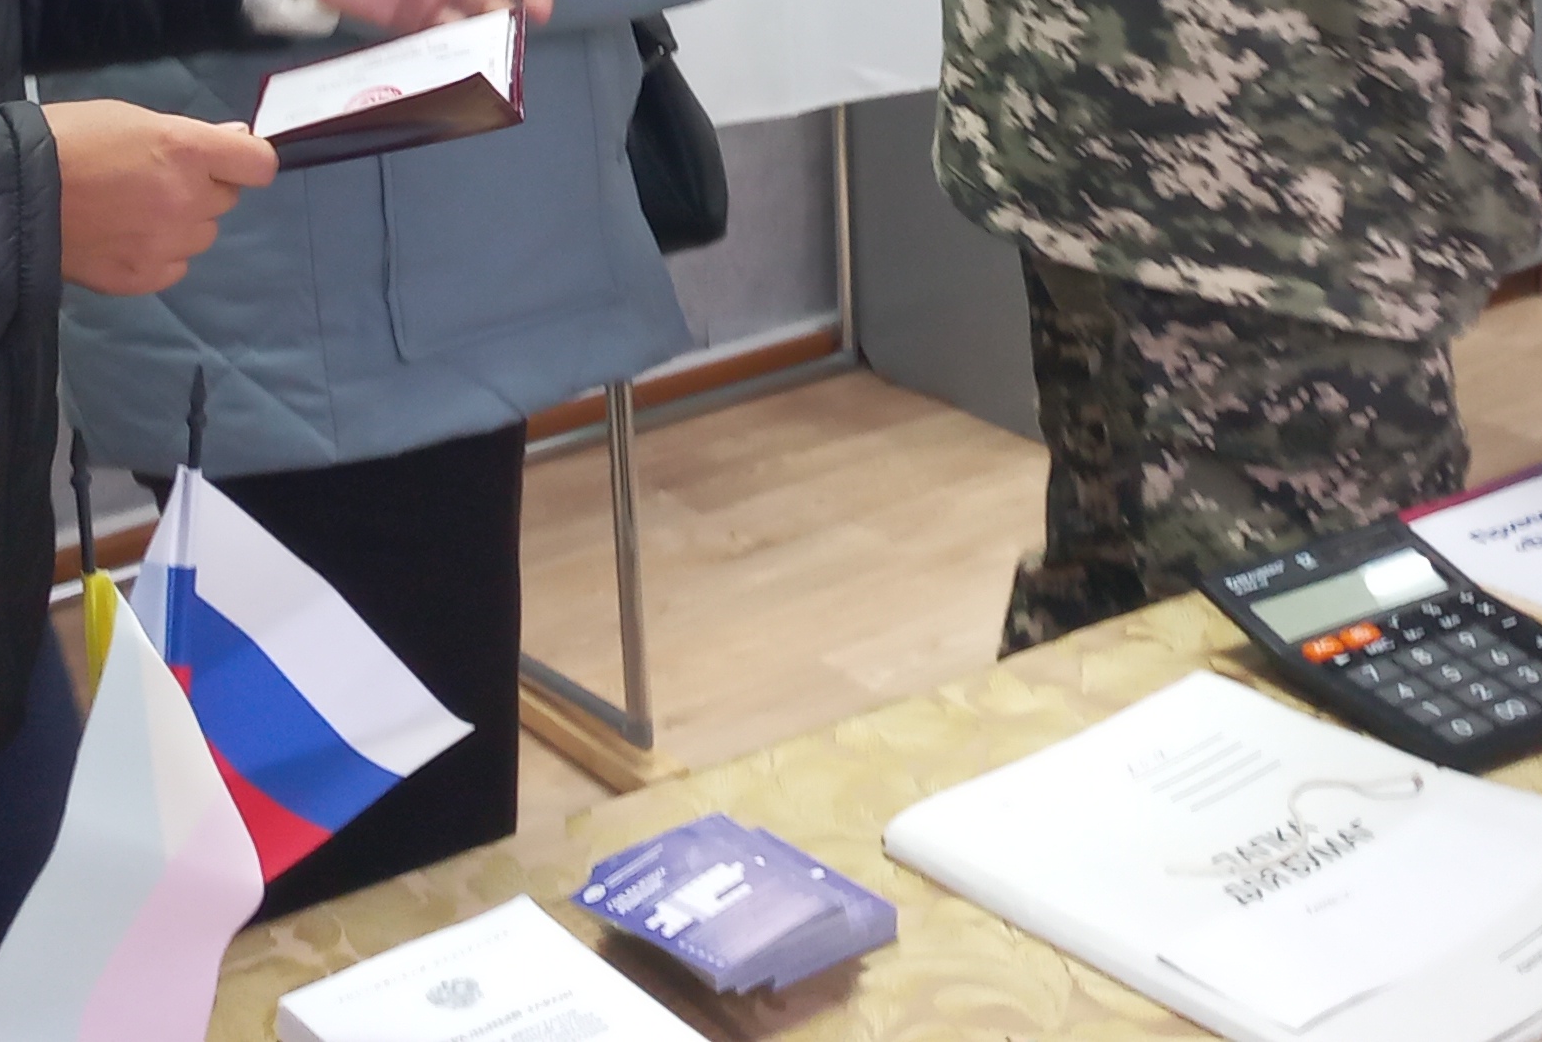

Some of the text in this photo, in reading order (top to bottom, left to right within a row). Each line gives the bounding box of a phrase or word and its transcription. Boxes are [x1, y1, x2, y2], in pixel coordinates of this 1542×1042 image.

[1361, 631, 1477, 682] 7 8 9
[1397, 648, 1510, 699] 4 5 6
[1421, 665, 1540, 717] 1 2 3
